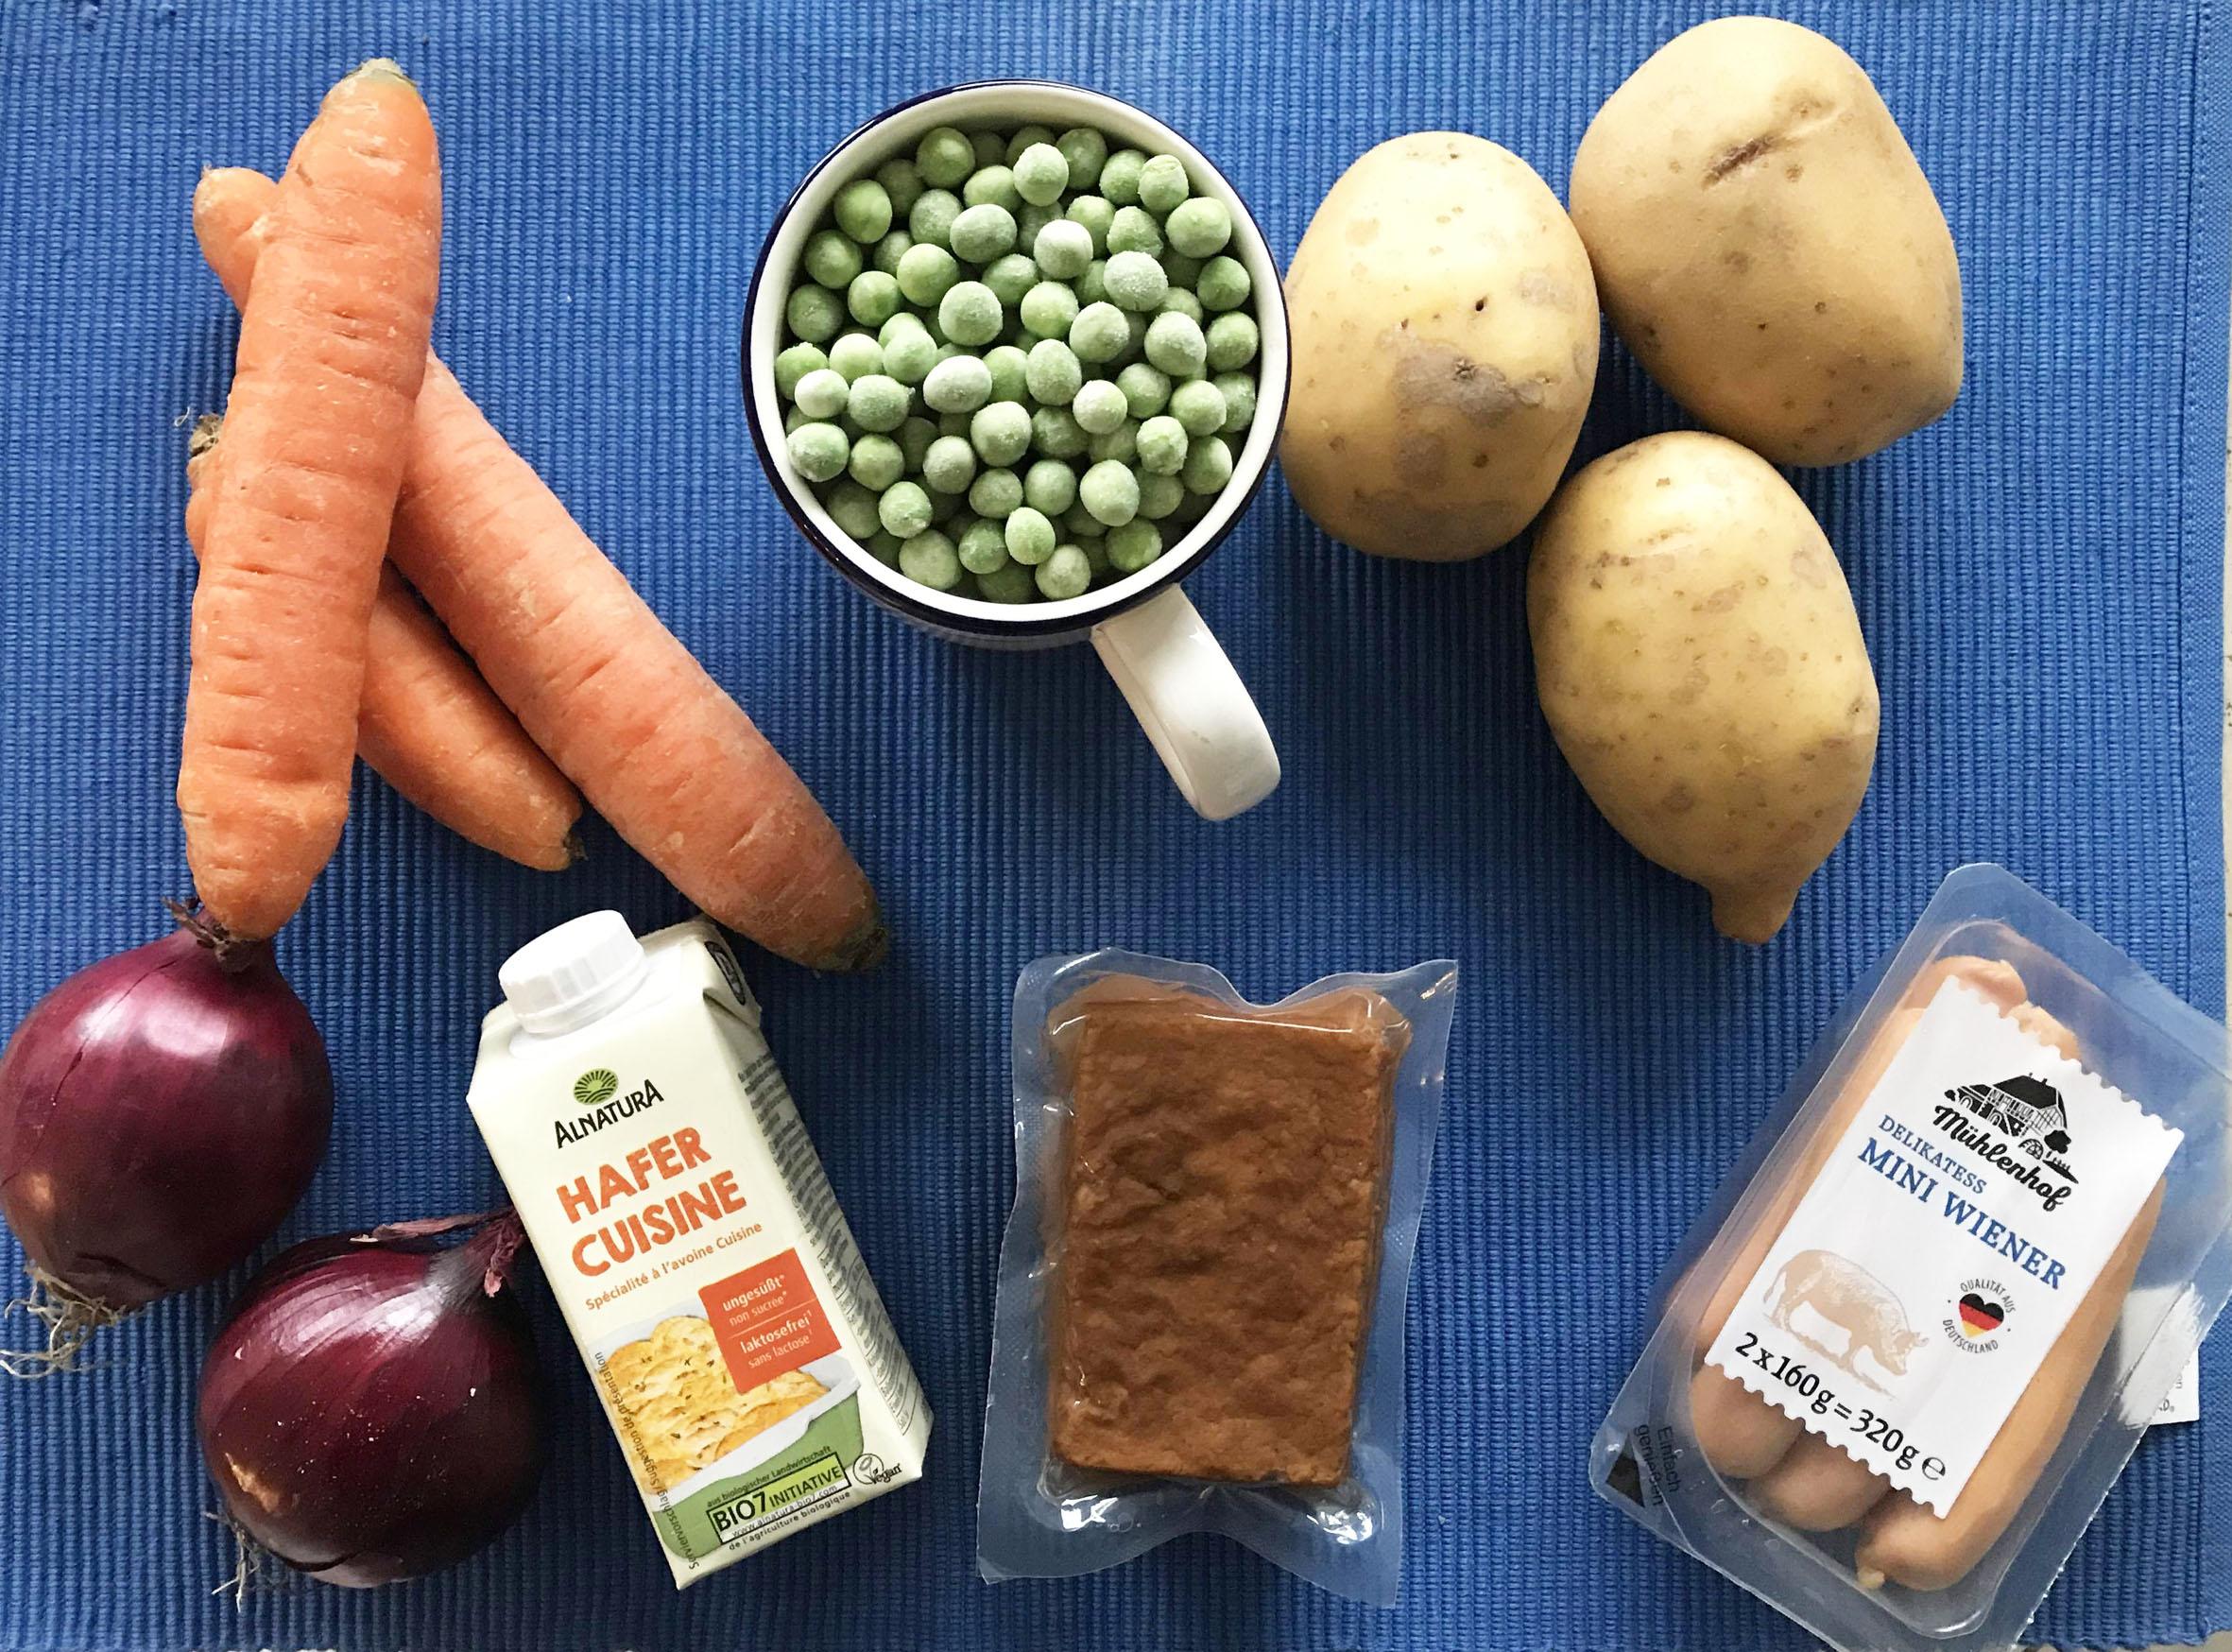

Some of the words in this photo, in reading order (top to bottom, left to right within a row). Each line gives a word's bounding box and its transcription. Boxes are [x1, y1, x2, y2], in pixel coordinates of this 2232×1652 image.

[554, 1079, 664, 1149] ALNATURA
[556, 1127, 712, 1223] HAFER
[1878, 1114, 1987, 1195] DELIKATESS
[1932, 1105, 2071, 1213] Mühlenhof
[572, 1170, 747, 1276] CUISINE
[1858, 1137, 1938, 1203] MINI
[1943, 1191, 2067, 1290] WIENER
[585, 1272, 649, 1311] Spécialité
[652, 1268, 661, 1280] à
[715, 1223, 763, 1249] Cuisine
[729, 1311, 750, 1327] non
[1942, 1319, 1999, 1354] DEUTSCHLAND
[2001, 1295, 2016, 1314] AUS
[747, 1351, 772, 1368] sans
[624, 1415, 635, 1428] de
[707, 1497, 722, 1507] aus
[722, 1474, 770, 1501] biologischer
[771, 1445, 832, 1476] Landwirtschaft
[1657, 1425, 1682, 1493] Einfach
[713, 1491, 766, 1532] BIO7
[769, 1466, 842, 1507] INITIATIVE
[729, 1540, 741, 1551] de
[802, 1491, 850, 1519] biologique
